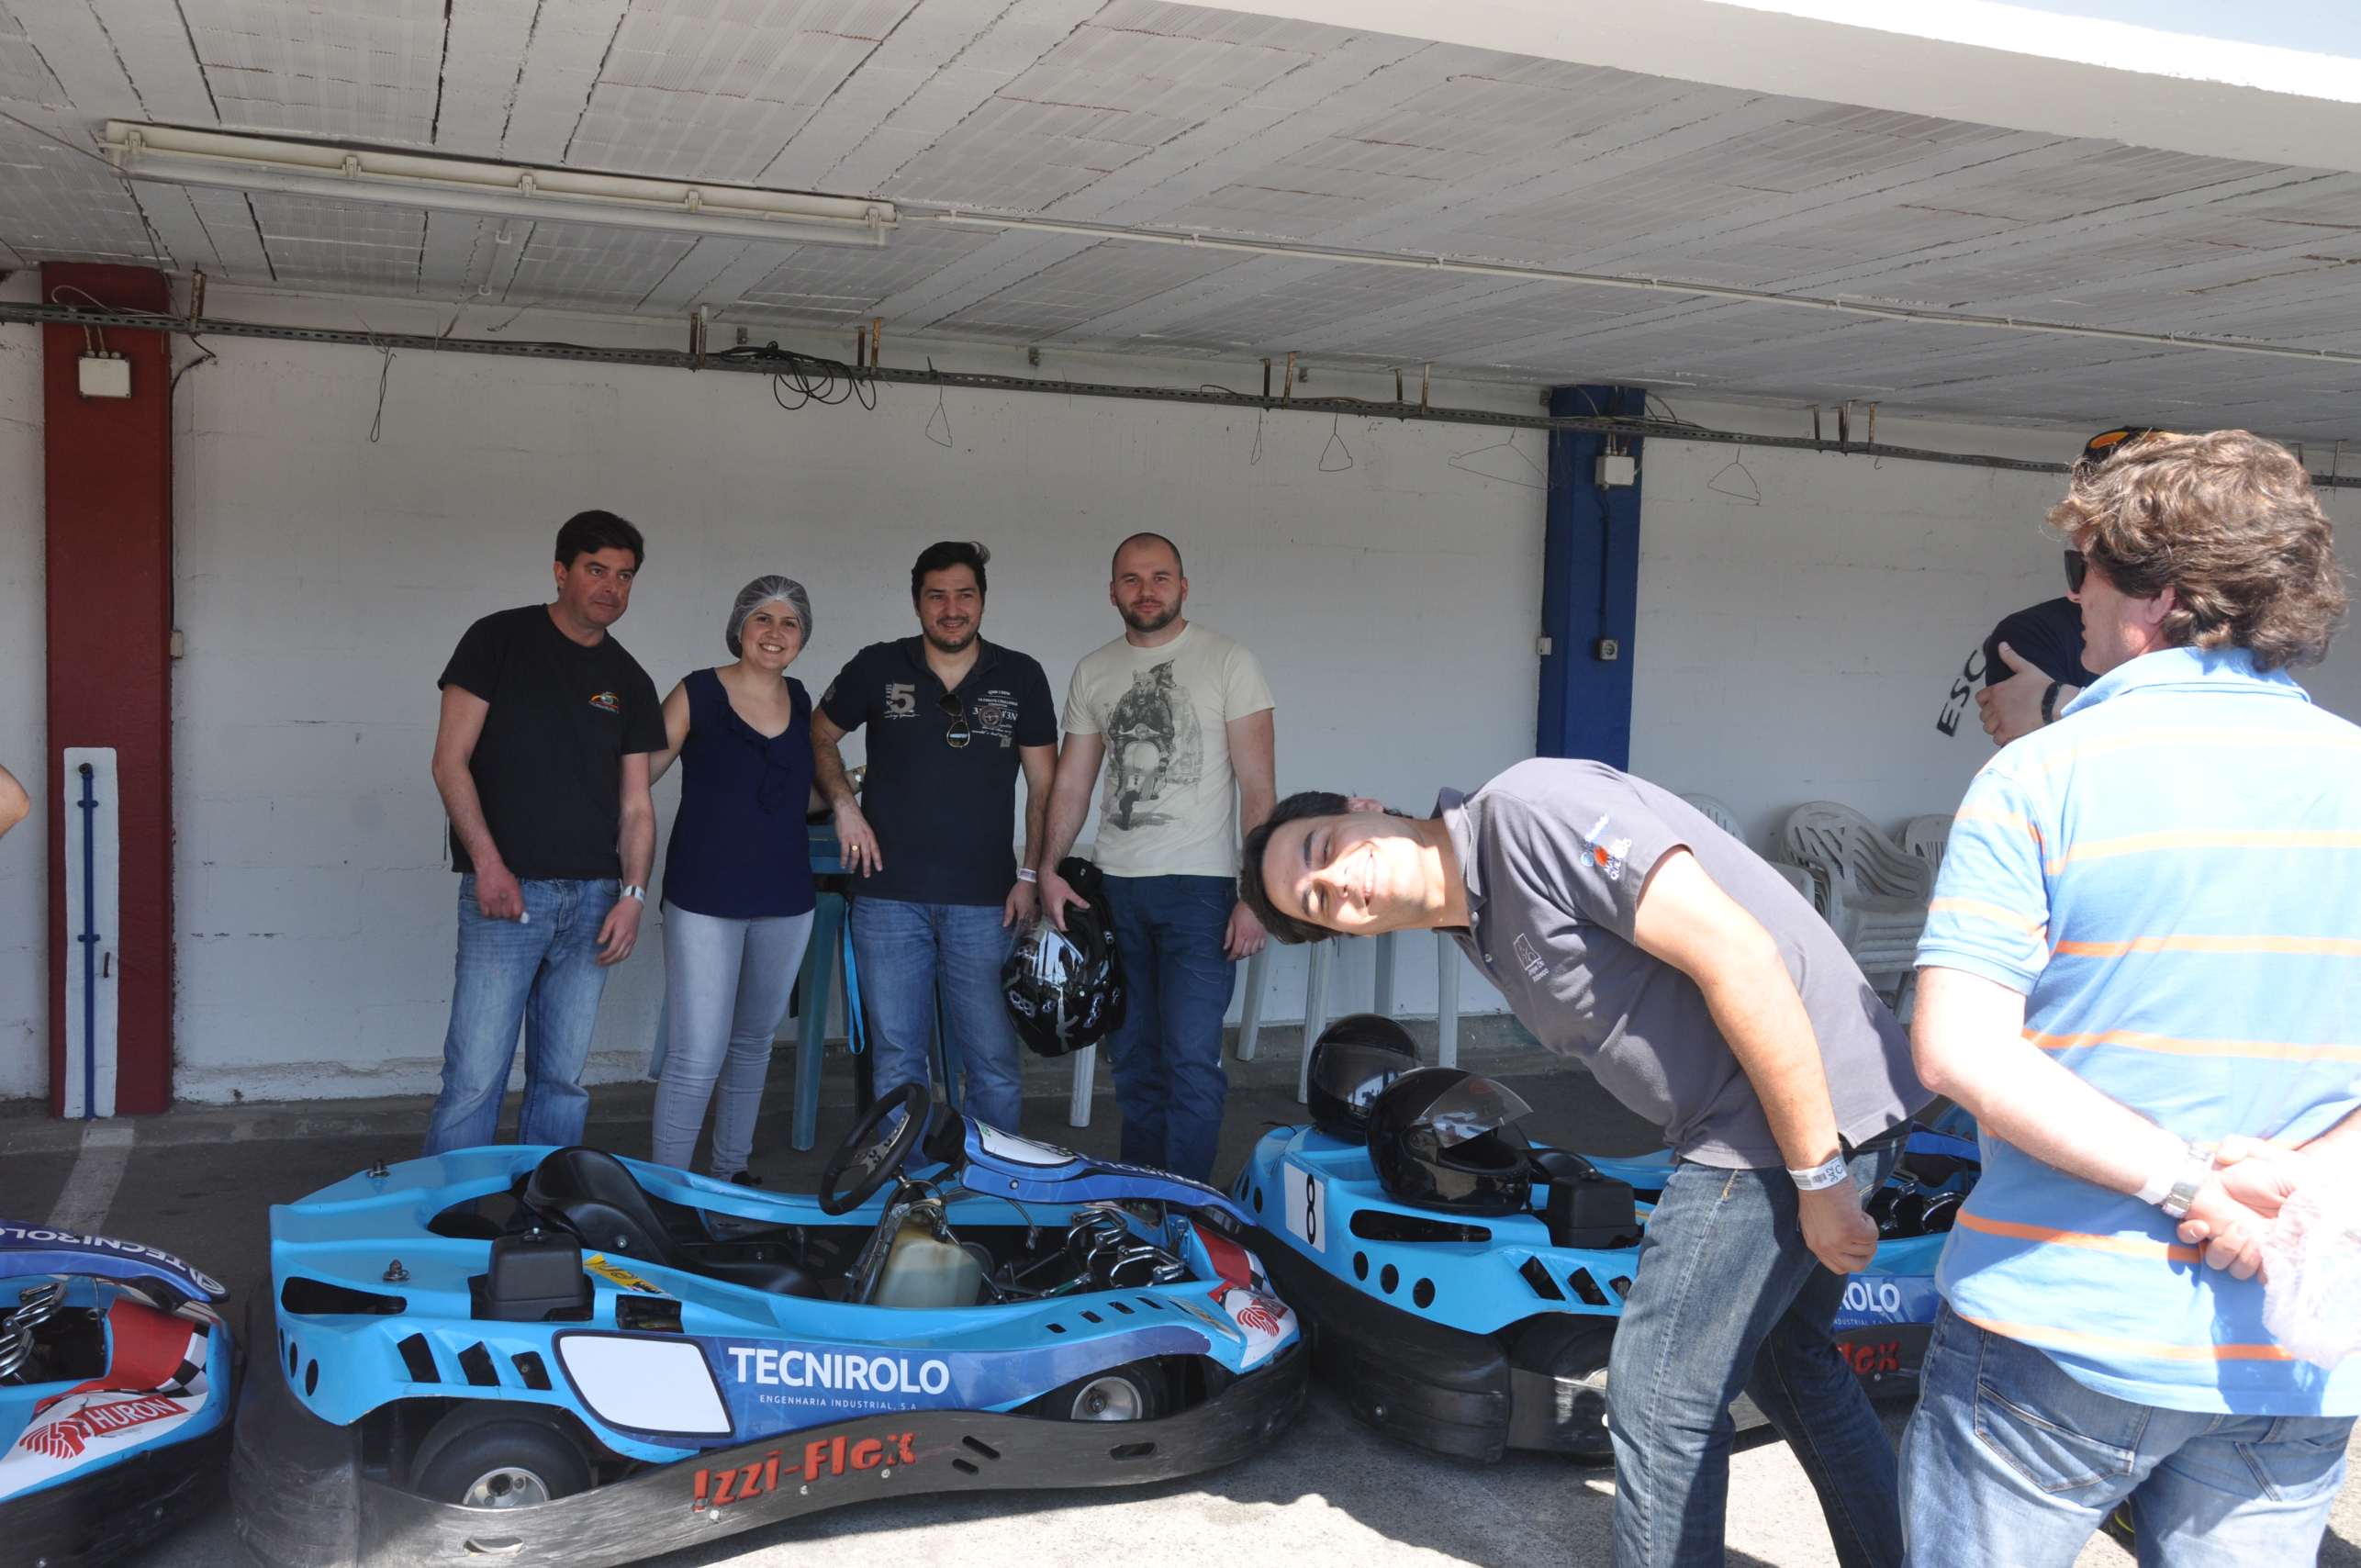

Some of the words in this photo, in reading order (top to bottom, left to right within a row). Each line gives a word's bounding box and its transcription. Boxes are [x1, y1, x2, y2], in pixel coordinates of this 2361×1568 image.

[890, 683, 915, 713] 5
[1936, 634, 1991, 737] ESC
[1305, 1173, 1316, 1245] 8
[0, 1227, 186, 1271] TECNIROL
[728, 1347, 950, 1395] TECNIROLO
[85, 1398, 173, 1429] HURON
[760, 1394, 827, 1406] ENGENHARIA
